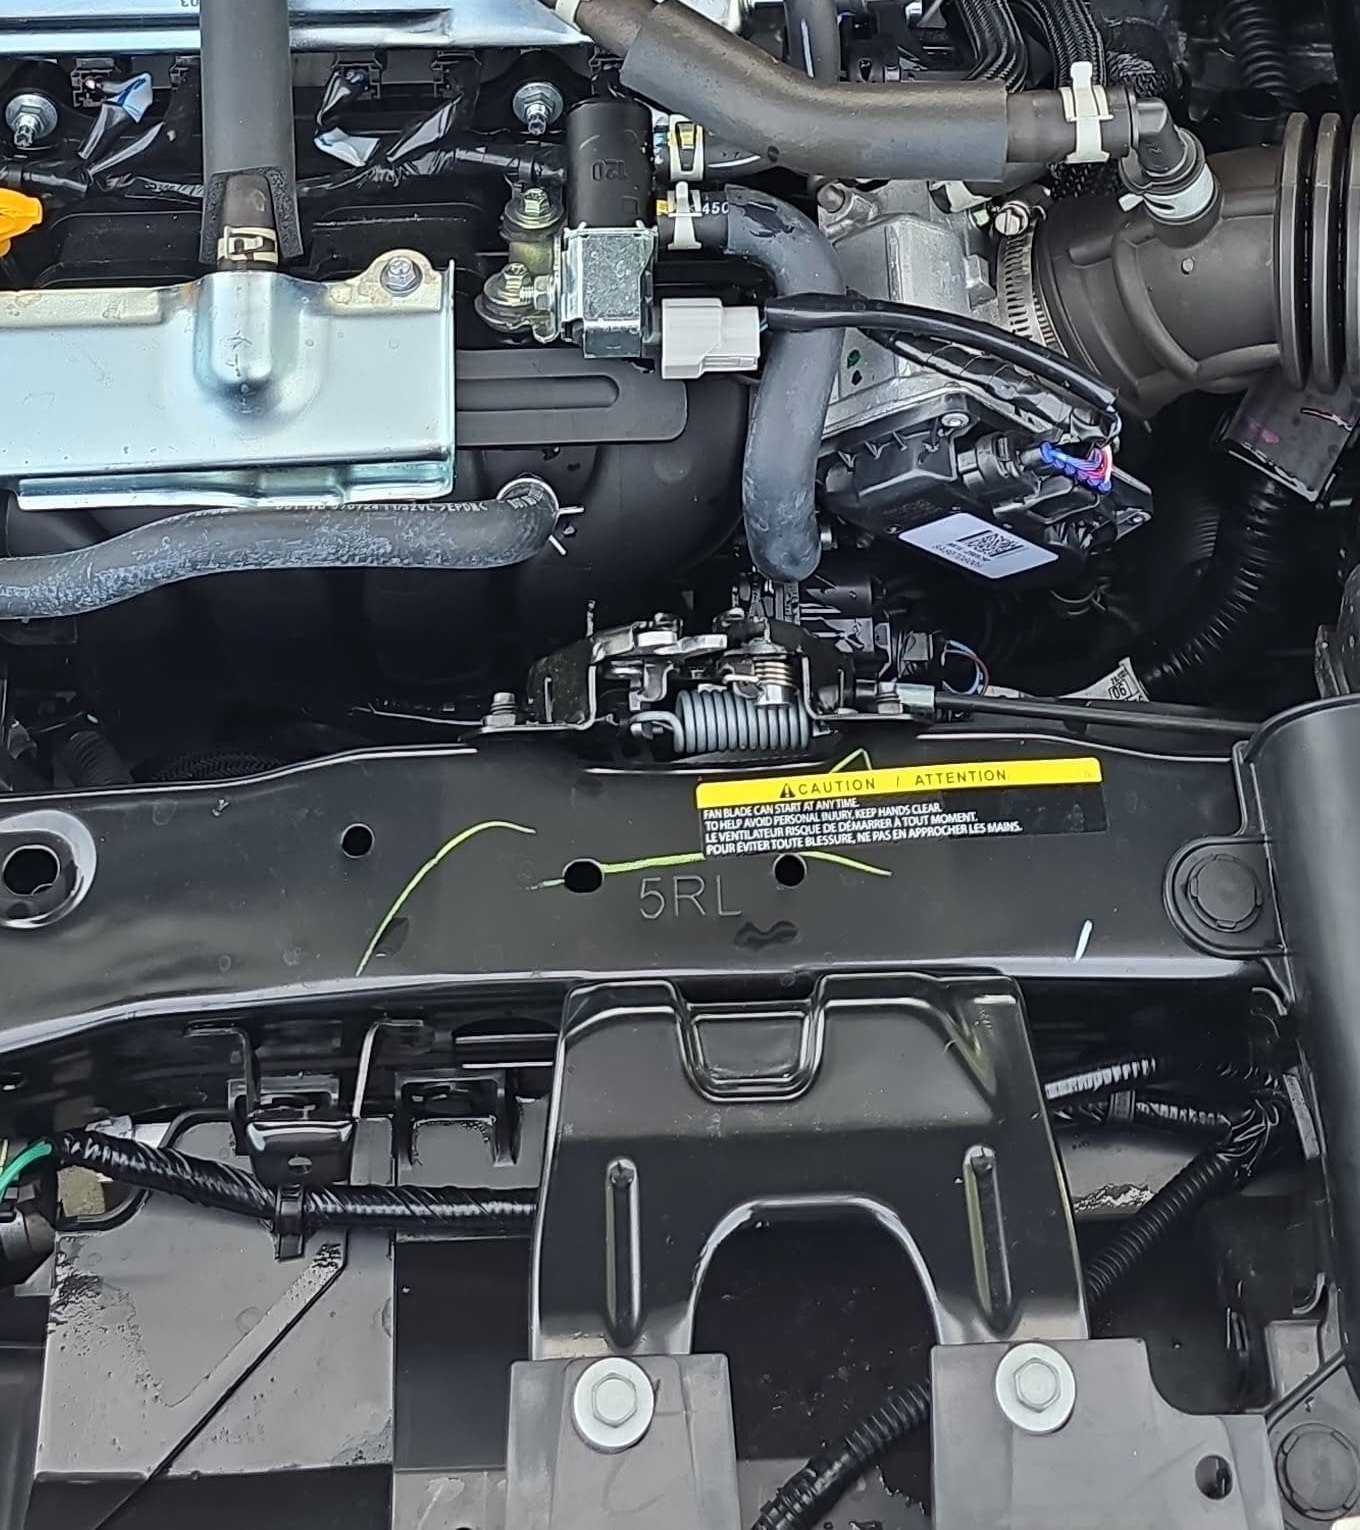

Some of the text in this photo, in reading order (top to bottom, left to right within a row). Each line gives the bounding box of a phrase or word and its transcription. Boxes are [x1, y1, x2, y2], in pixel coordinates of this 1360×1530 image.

[798, 778, 875, 795] CAUTION
[915, 770, 1006, 786] ATTENTION
[703, 809, 722, 819] FAN
[724, 806, 753, 818] BLADE
[754, 804, 773, 816] CAN
[774, 803, 801, 815] START
[805, 802, 815, 811] AT
[816, 800, 834, 810] ANY
[704, 820, 718, 831] TO
[720, 818, 743, 830] HELP
[744, 816, 772, 828] AVOID
[773, 812, 821, 826] PERSONAL
[855, 807, 877, 819] KEEP
[878, 804, 911, 818] HANDS
[706, 833, 718, 843] LE
[719, 826, 785, 842] VENTILATEUR
[785, 823, 823, 837] RISQUE
[825, 822, 837, 833] DE
[838, 817, 893, 831] DÉMARRER
[902, 815, 929, 826] TOUT
[706, 843, 736, 855] POUR
[737, 840, 770, 853] ÉVITER
[771, 838, 804, 850] TOUTE
[857, 832, 871, 842] NE
[872, 829, 891, 841] PAS
[893, 829, 907, 840] EN
[908, 824, 968, 839] APPROCHER
[969, 823, 986, 834] LES
[638, 874, 743, 920] 5RL
